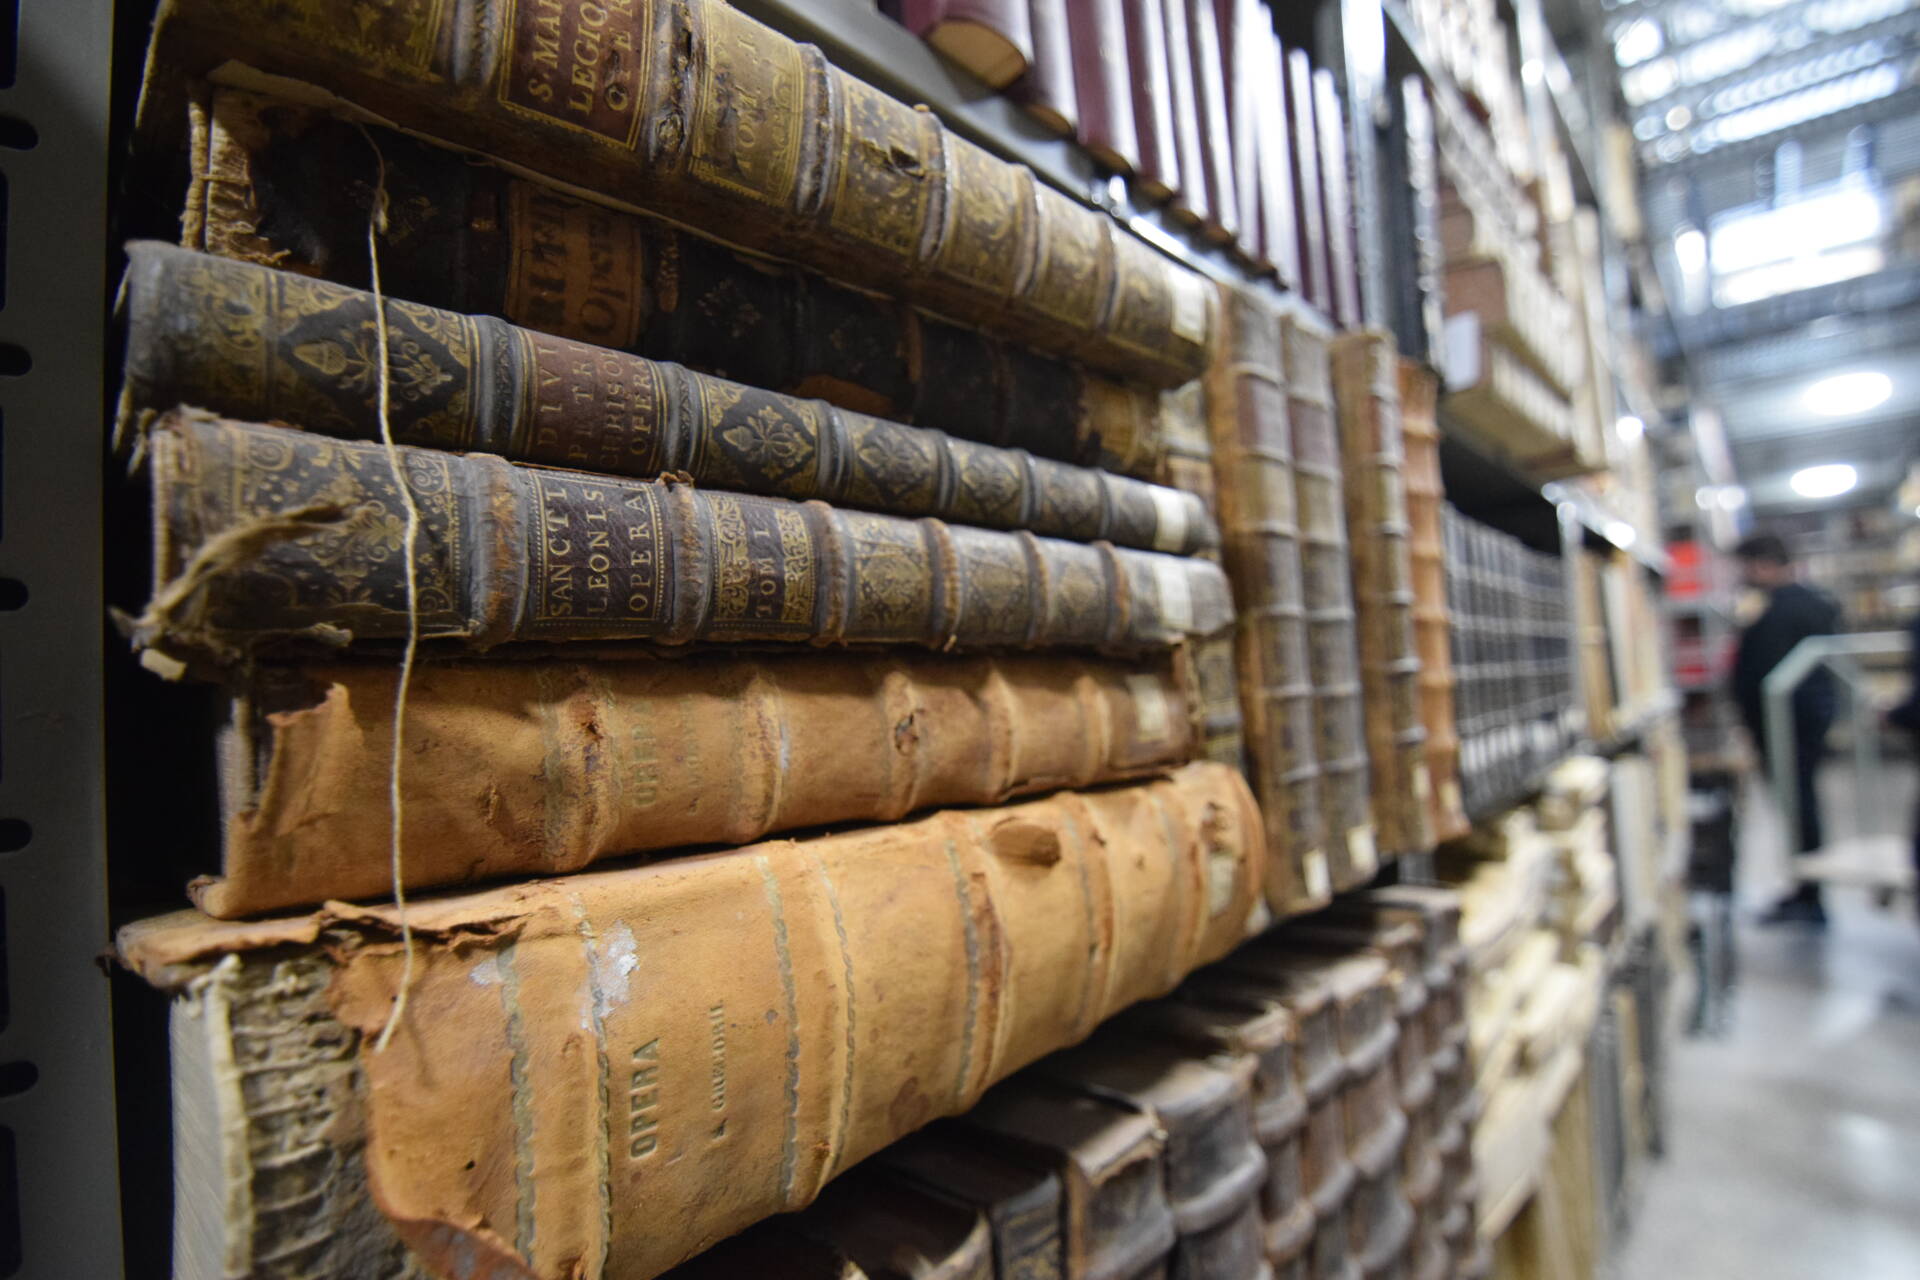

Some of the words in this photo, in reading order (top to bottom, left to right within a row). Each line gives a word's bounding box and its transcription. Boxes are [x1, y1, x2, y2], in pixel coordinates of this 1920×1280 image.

[537, 346, 562, 445] DIVI
[630, 360, 653, 455] OPERA
[546, 488, 573, 617] SANCTI
[584, 488, 610, 615] LEONIS
[625, 496, 651, 612] OPERA
[755, 557, 778, 617] TOM
[630, 1038, 660, 1160] OPERA
